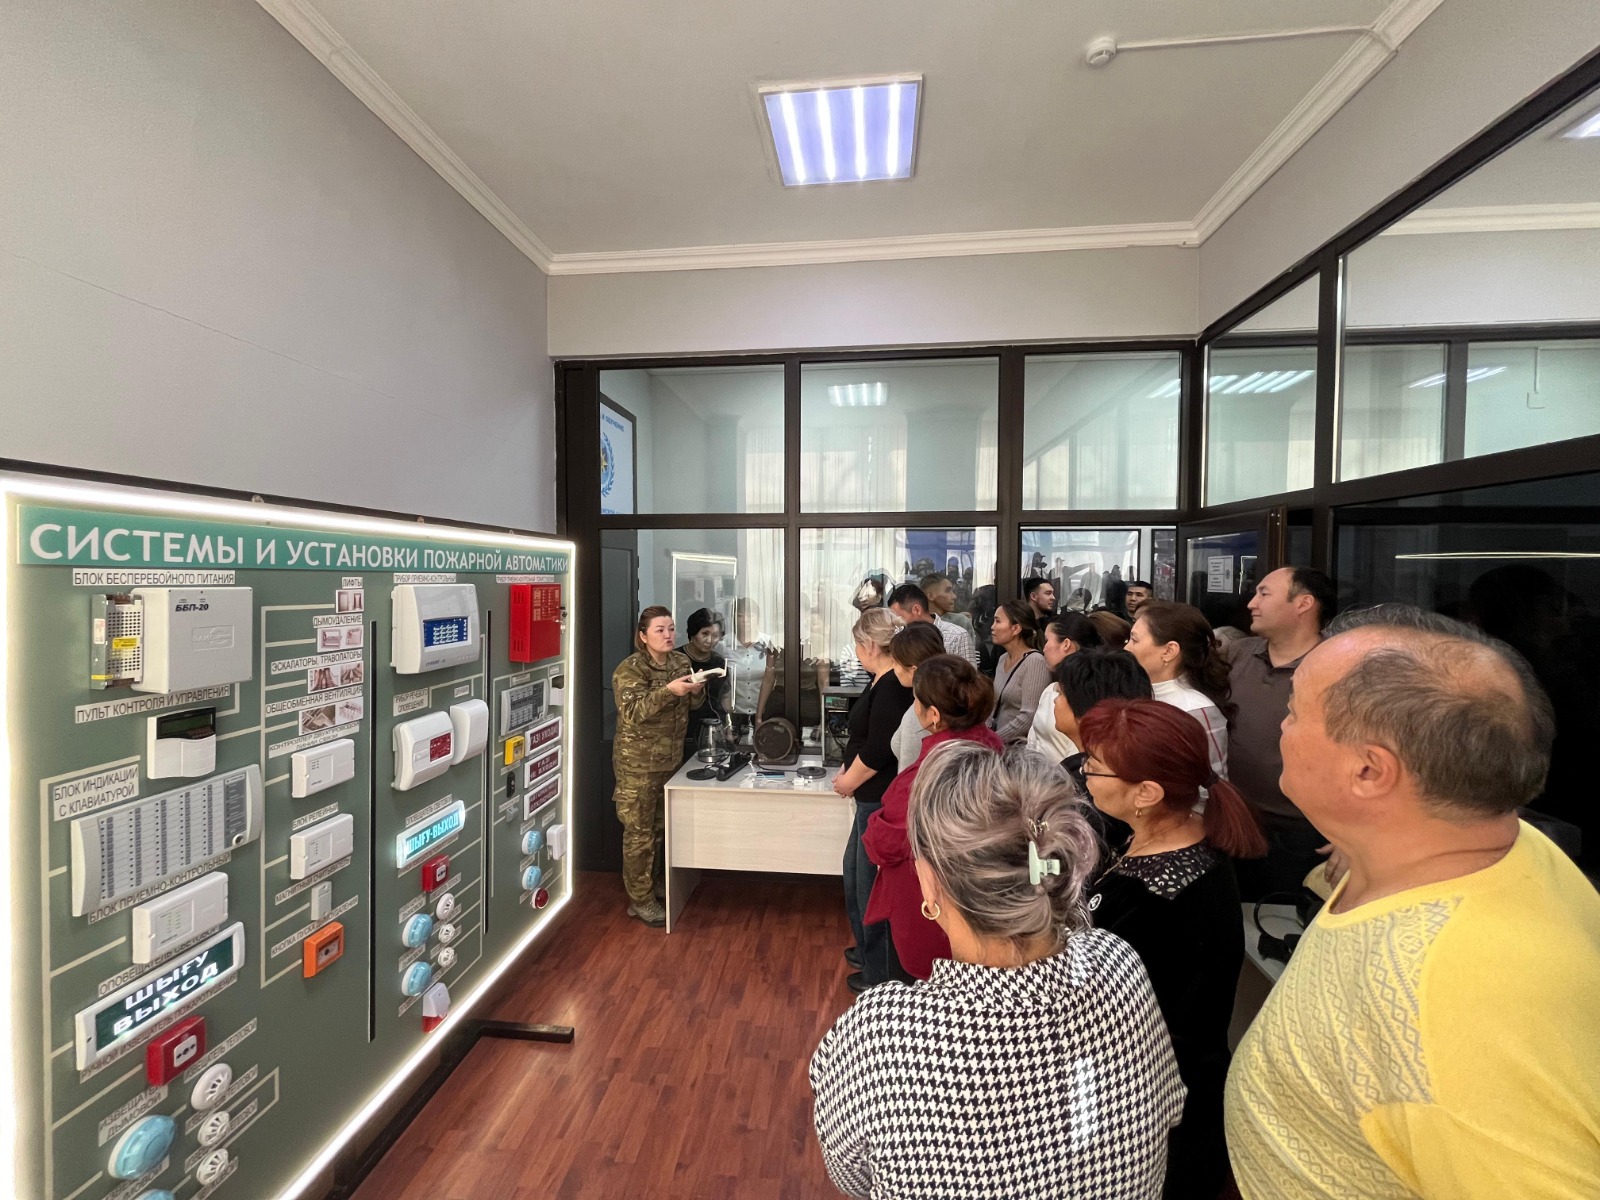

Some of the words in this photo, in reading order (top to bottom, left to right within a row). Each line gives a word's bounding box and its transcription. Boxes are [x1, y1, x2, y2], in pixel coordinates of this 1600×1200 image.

[30, 523, 243, 564] СИСТЕМЫ
[256, 539, 276, 564] И
[286, 540, 418, 568] УСТАНОВКИ
[423, 549, 502, 571] ПОЖАРНОЙ
[505, 555, 568, 573] АВТОМАТИКИ
[74, 572, 103, 585] БЛОК
[106, 571, 196, 585] БЕСПЕРЕБОЙНОГО
[197, 573, 235, 585] ПИТАНИЯ
[343, 578, 362, 587] ЛИФТЫ
[175, 603, 209, 613] ББП-20
[313, 615, 362, 626] ДЫМОУДАЛЕНИЕ
[321, 651, 362, 664] ТРАВОЛАТОРЫ
[76, 706, 110, 723] ПУЛЬТ
[113, 696, 165, 716] КОНТРОЛЯ
[167, 695, 174, 706] И
[175, 686, 230, 704] УПРАВЛЕНИЯ
[265, 694, 323, 714] ОБЩЕОБМЕННАЯ
[324, 686, 362, 700] ВЕНТИЛЯЦИЯ
[54, 782, 81, 801] БЛОК
[82, 767, 139, 792] ИНДИКАЦИИ
[59, 804, 66, 817] С
[69, 783, 135, 815] КЛАВИАТУРОЙ
[89, 901, 118, 923] БЛОК
[119, 854, 230, 907] ПРИЕМНО-КОНТРОЛЬНЫЙ
[125, 950, 209, 1010] ШЫҒУ
[113, 962, 218, 1036] ВЫХОД
